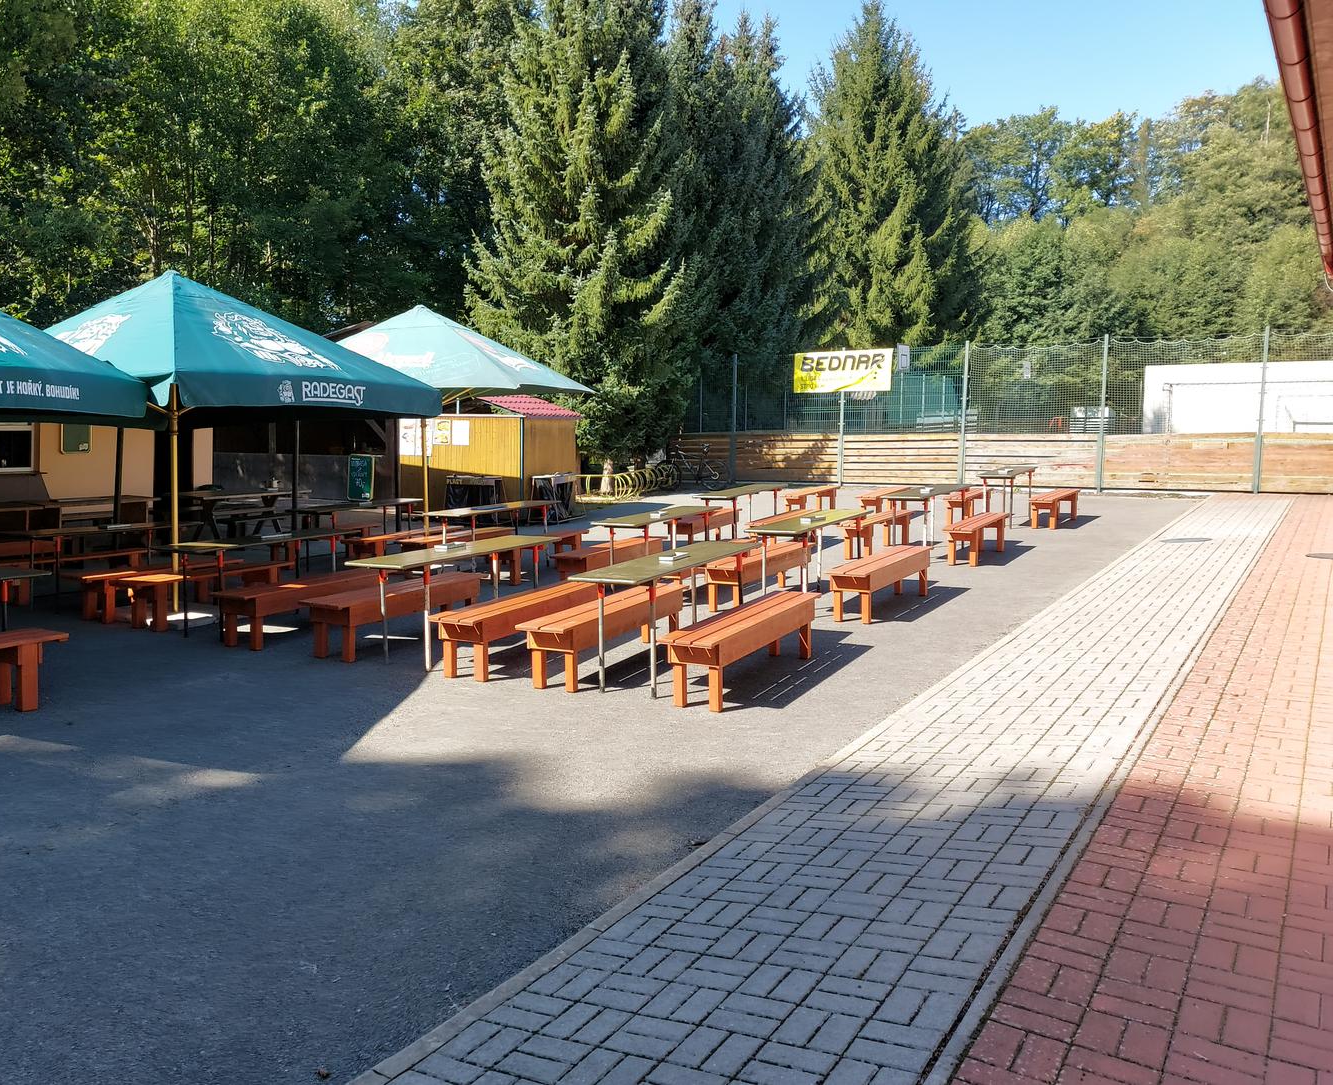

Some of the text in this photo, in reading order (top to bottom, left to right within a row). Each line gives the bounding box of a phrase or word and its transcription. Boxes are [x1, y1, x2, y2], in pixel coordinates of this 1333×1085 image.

[6, 381, 15, 394] JE
[17, 380, 44, 397] HOŘKÝ.
[46, 384, 80, 400] BOHUDÍK!
[302, 381, 366, 406] RADEGAST
